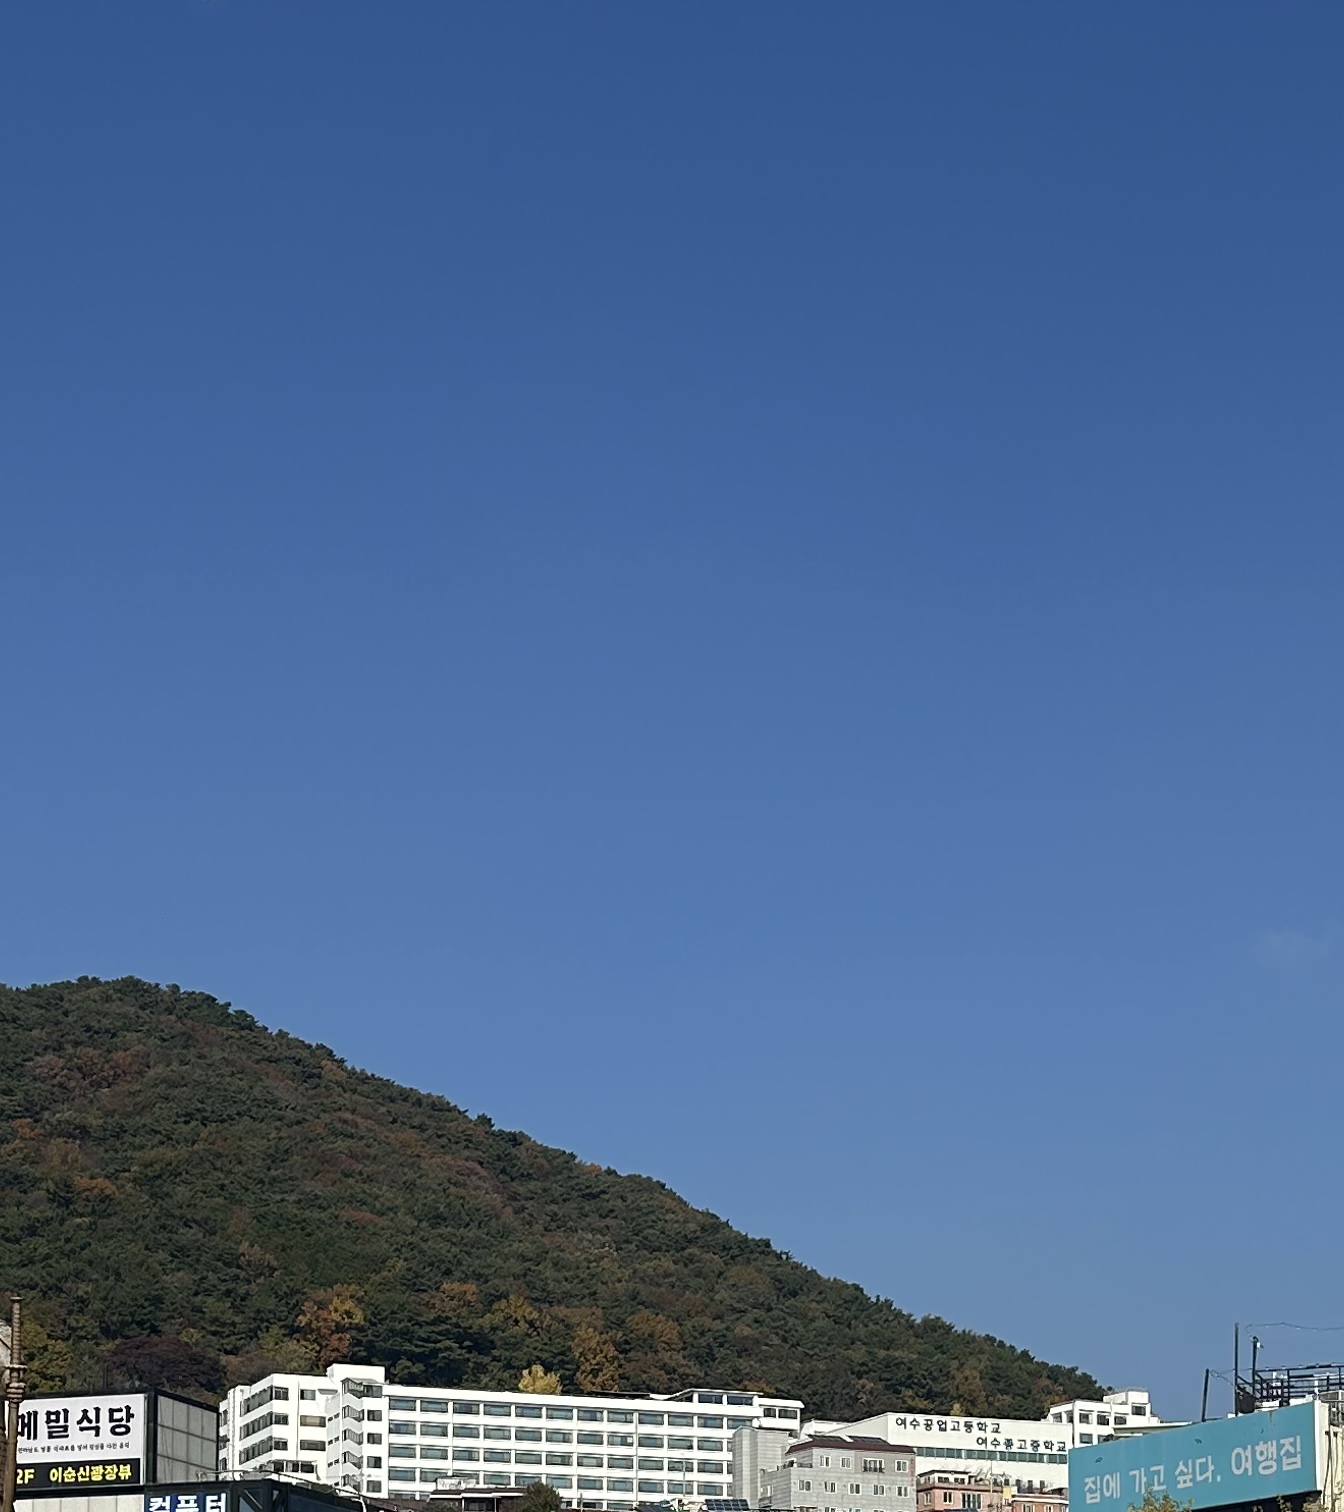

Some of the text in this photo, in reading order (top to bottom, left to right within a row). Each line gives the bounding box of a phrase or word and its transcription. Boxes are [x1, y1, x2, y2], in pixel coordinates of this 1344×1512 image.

[895, 1416, 1001, 1434] 여수공업고등학교
[1084, 1435, 1302, 1504] 집에 가고 싶다. 여행집
